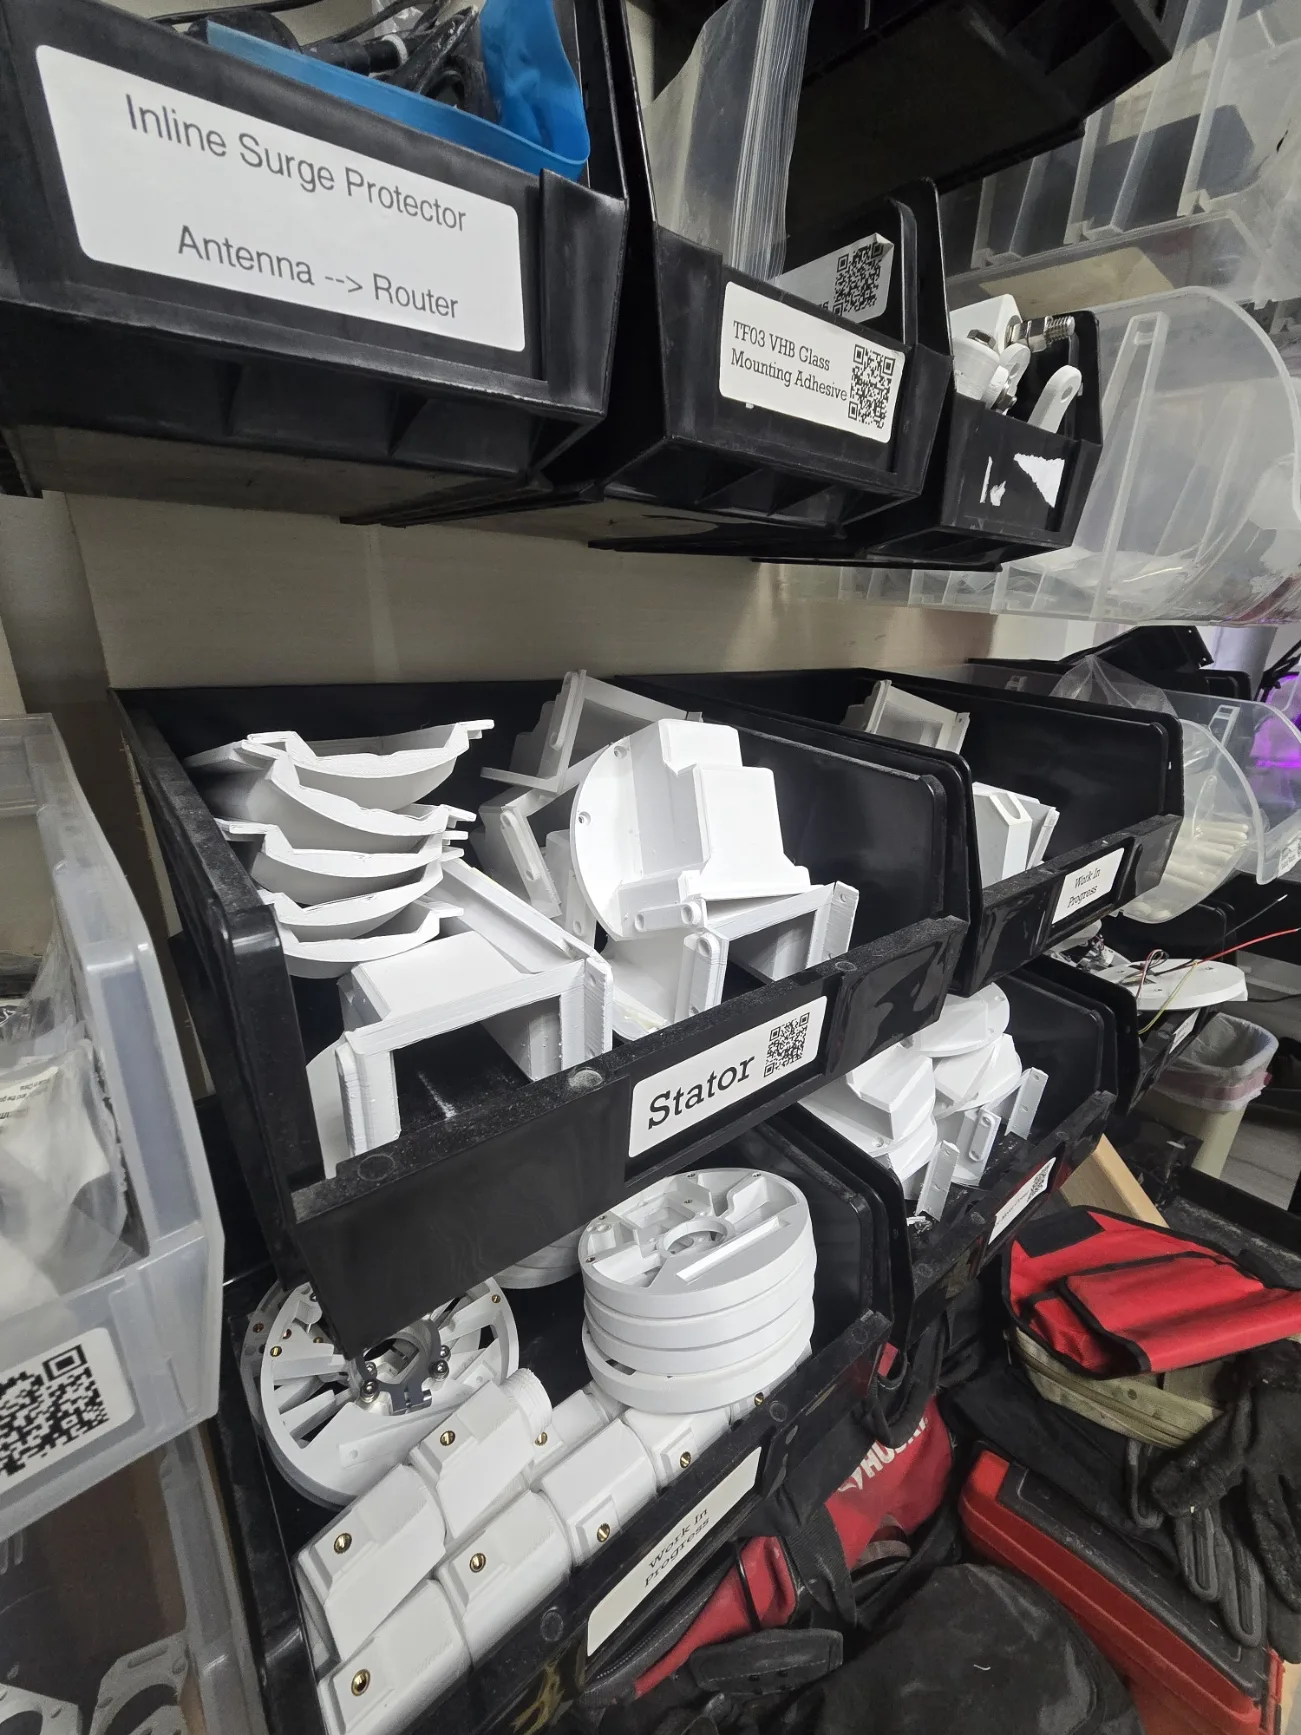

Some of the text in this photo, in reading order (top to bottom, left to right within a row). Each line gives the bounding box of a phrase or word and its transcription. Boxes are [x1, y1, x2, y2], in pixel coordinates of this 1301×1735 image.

[126, 93, 467, 232] Inline Surge Protector
[178, 224, 315, 286] Antenna
[373, 272, 459, 319] Router
[730, 347, 848, 401] Mounting Adhesive
[733, 320, 831, 371] TF03 VHB Glass
[1067, 885, 1098, 908] Progress
[1075, 870, 1094, 889] Work
[648, 1056, 756, 1130] Stator
[644, 1517, 710, 1588] Progress
[648, 1508, 708, 1569] Work In
